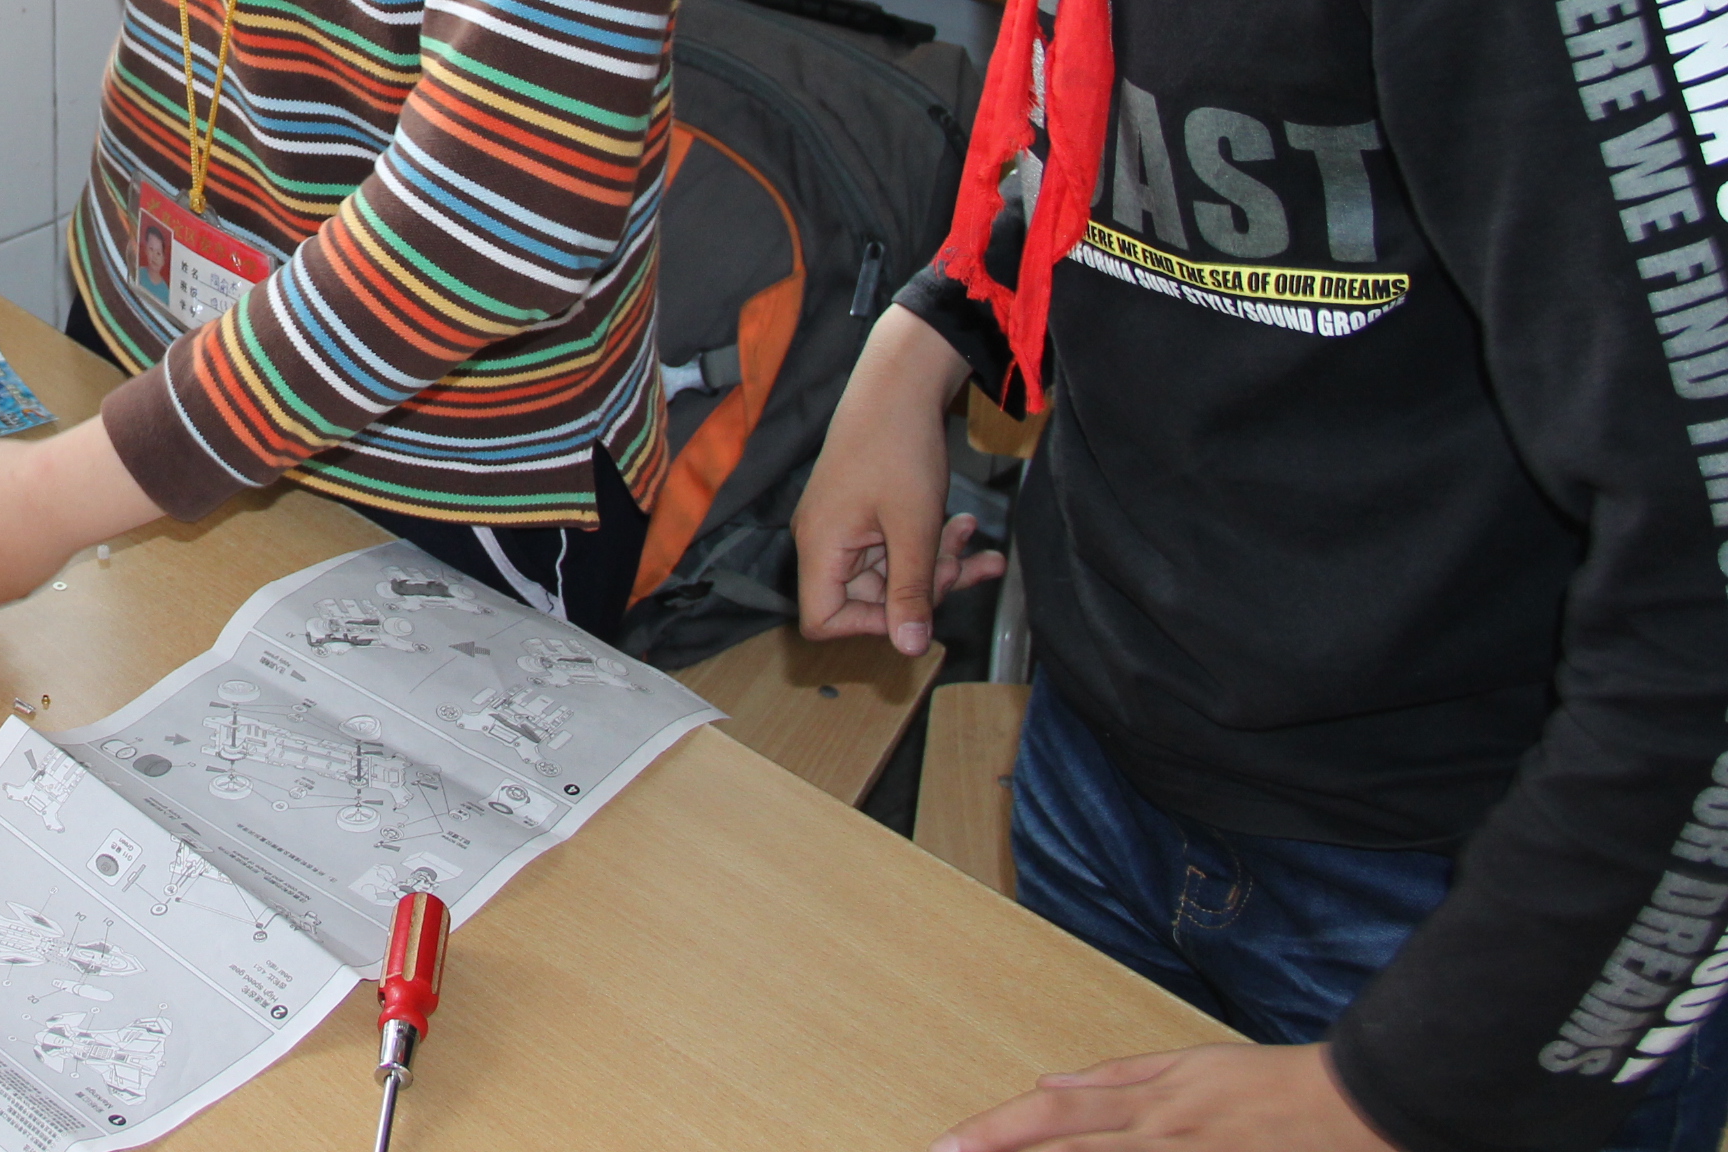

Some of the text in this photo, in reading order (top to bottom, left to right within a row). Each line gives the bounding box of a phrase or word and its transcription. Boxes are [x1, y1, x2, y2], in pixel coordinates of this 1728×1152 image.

[1091, 77, 1381, 263] AST
[1599, 111, 1706, 244] WE
[1117, 237, 1141, 262] WE
[1141, 247, 1176, 276] FIND
[1177, 261, 1207, 286] THE
[1209, 268, 1244, 293] SEA
[1247, 272, 1271, 294] OF
[1274, 273, 1316, 297] OUR
[1319, 276, 1407, 301] DREAMS
[1134, 267, 1182, 299] SURF
[1636, 236, 1728, 400] FIND
[228, 964, 279, 1003] High speed gear
[278, 968, 293, 983] Gear
[1538, 870, 1728, 1076] DREAMS
[85, 1086, 114, 1109] Markings
